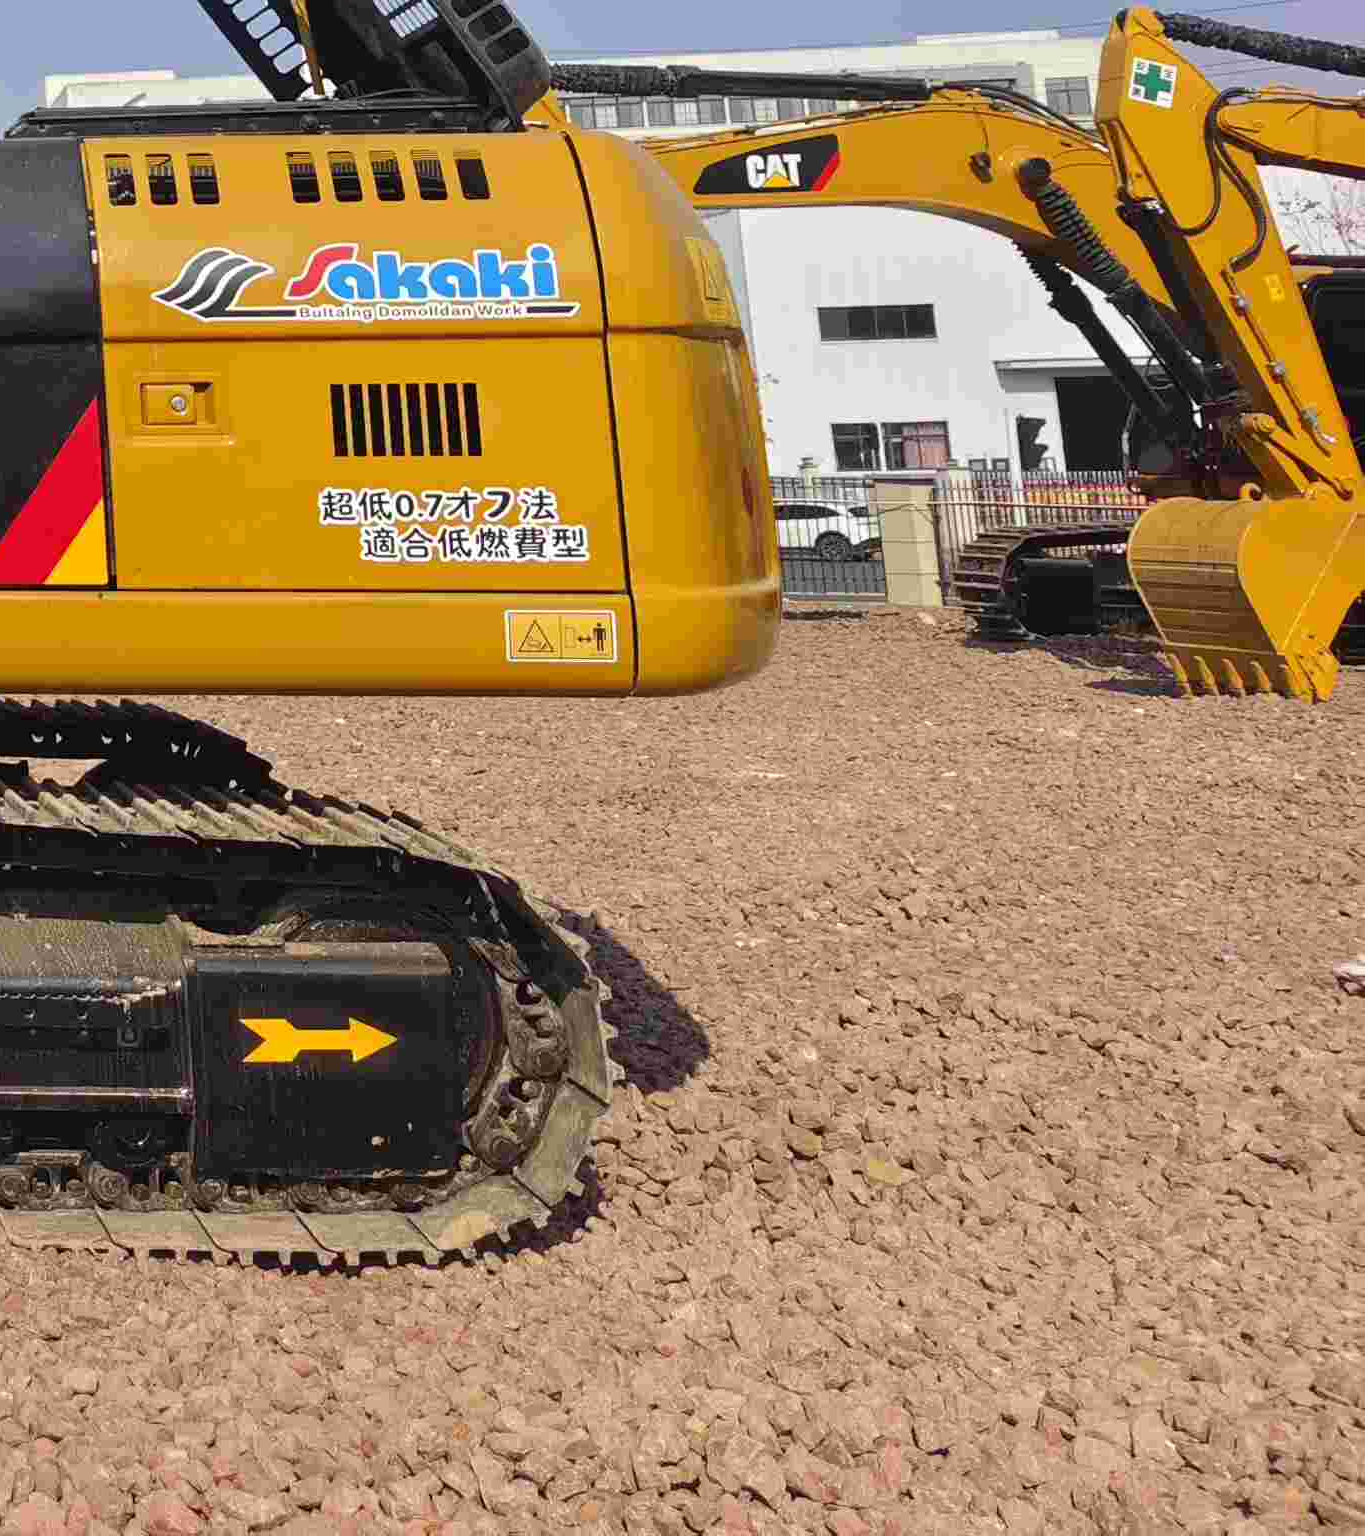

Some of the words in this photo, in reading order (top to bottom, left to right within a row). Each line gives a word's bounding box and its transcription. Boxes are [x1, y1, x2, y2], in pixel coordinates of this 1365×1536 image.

[746, 154, 801, 189] CAT
[286, 244, 558, 300] Sakaki
[477, 305, 523, 317] Work
[363, 528, 587, 559] 適合低燃費型
